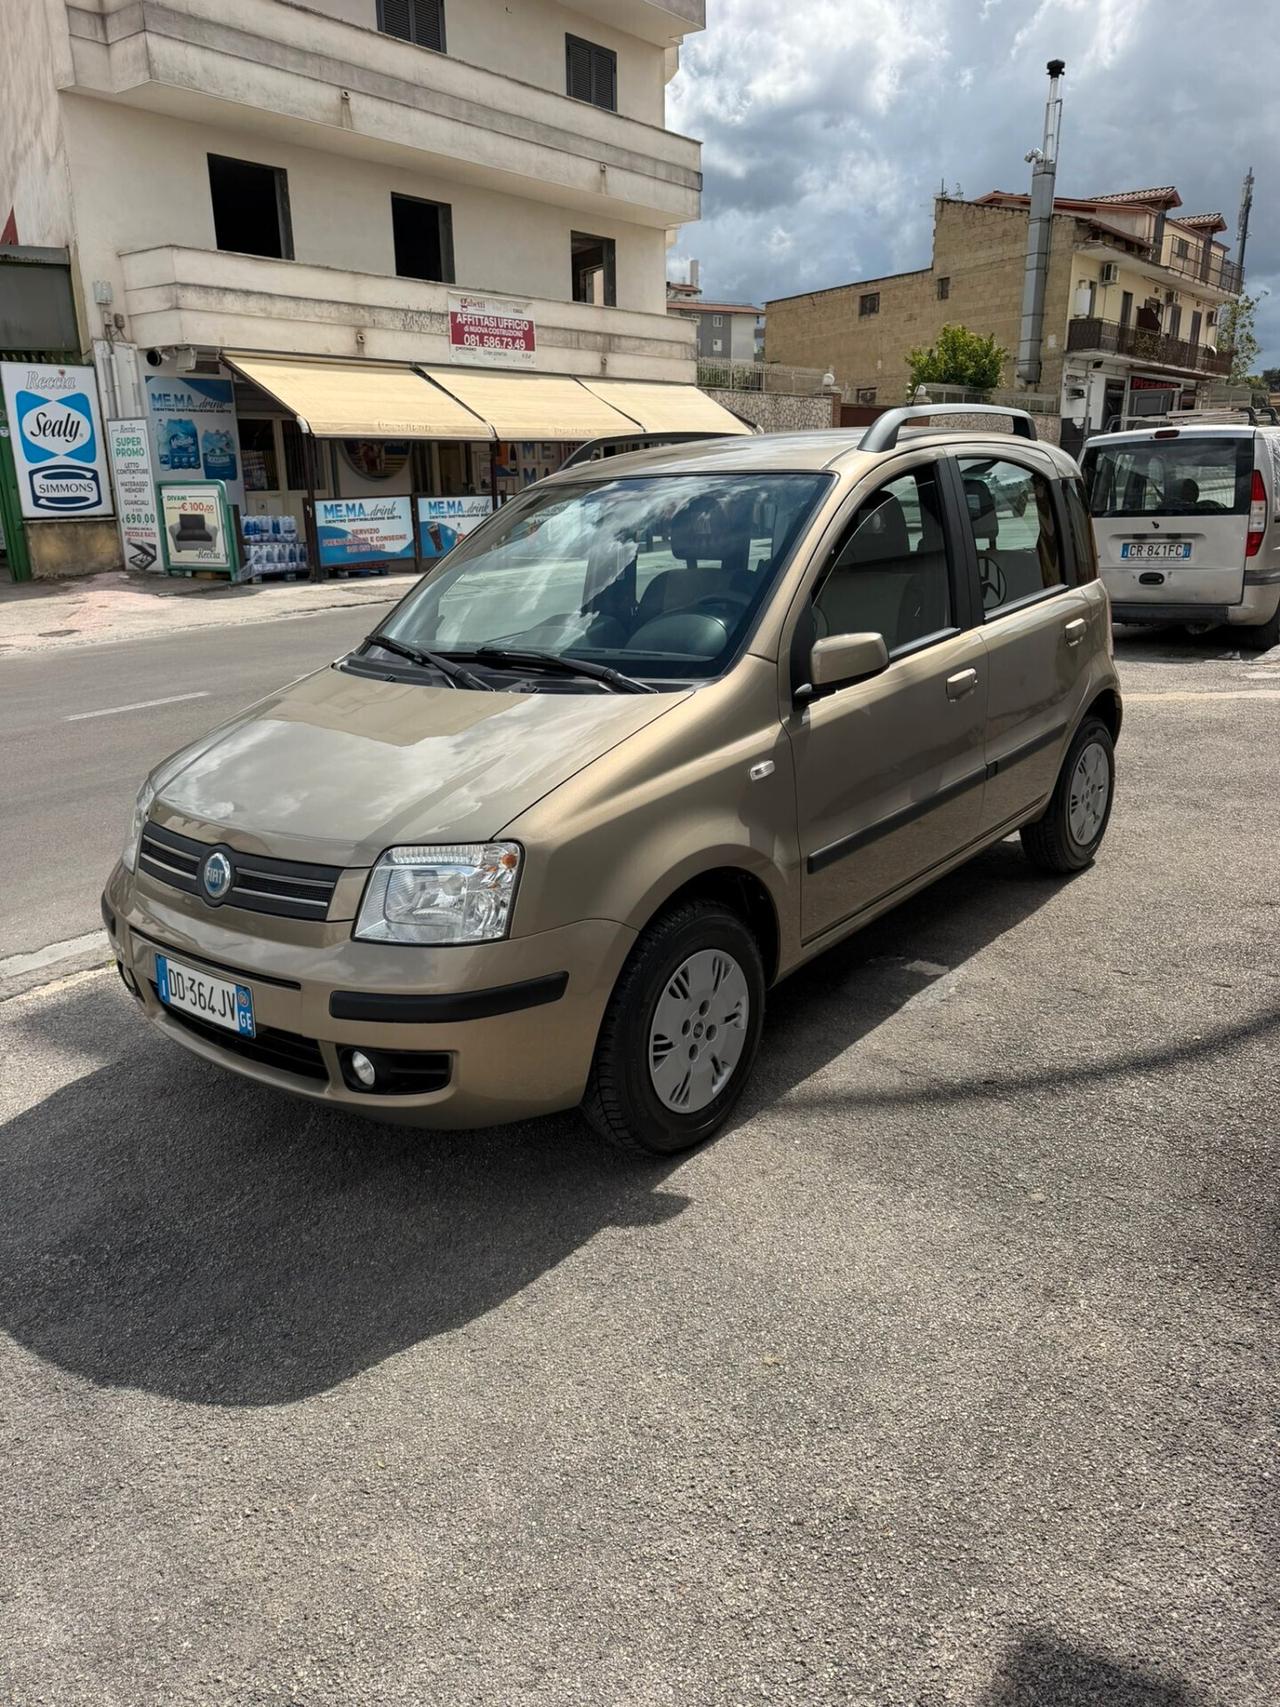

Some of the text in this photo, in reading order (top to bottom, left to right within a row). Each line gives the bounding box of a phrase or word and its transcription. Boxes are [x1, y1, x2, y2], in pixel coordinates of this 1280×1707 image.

[456, 313, 529, 331] AFFITTASI UFFICIO
[469, 326, 488, 334] NUOVA
[489, 328, 524, 338] COSTRUZIONE
[30, 412, 80, 443] Sealy
[116, 437, 142, 448] SUPER
[116, 448, 145, 458] PROMO
[39, 483, 94, 494] SIMMONS
[352, 528, 380, 536] SERVIZIO
[205, 866, 225, 885] FIAT
[239, 1009, 253, 1031] GE
